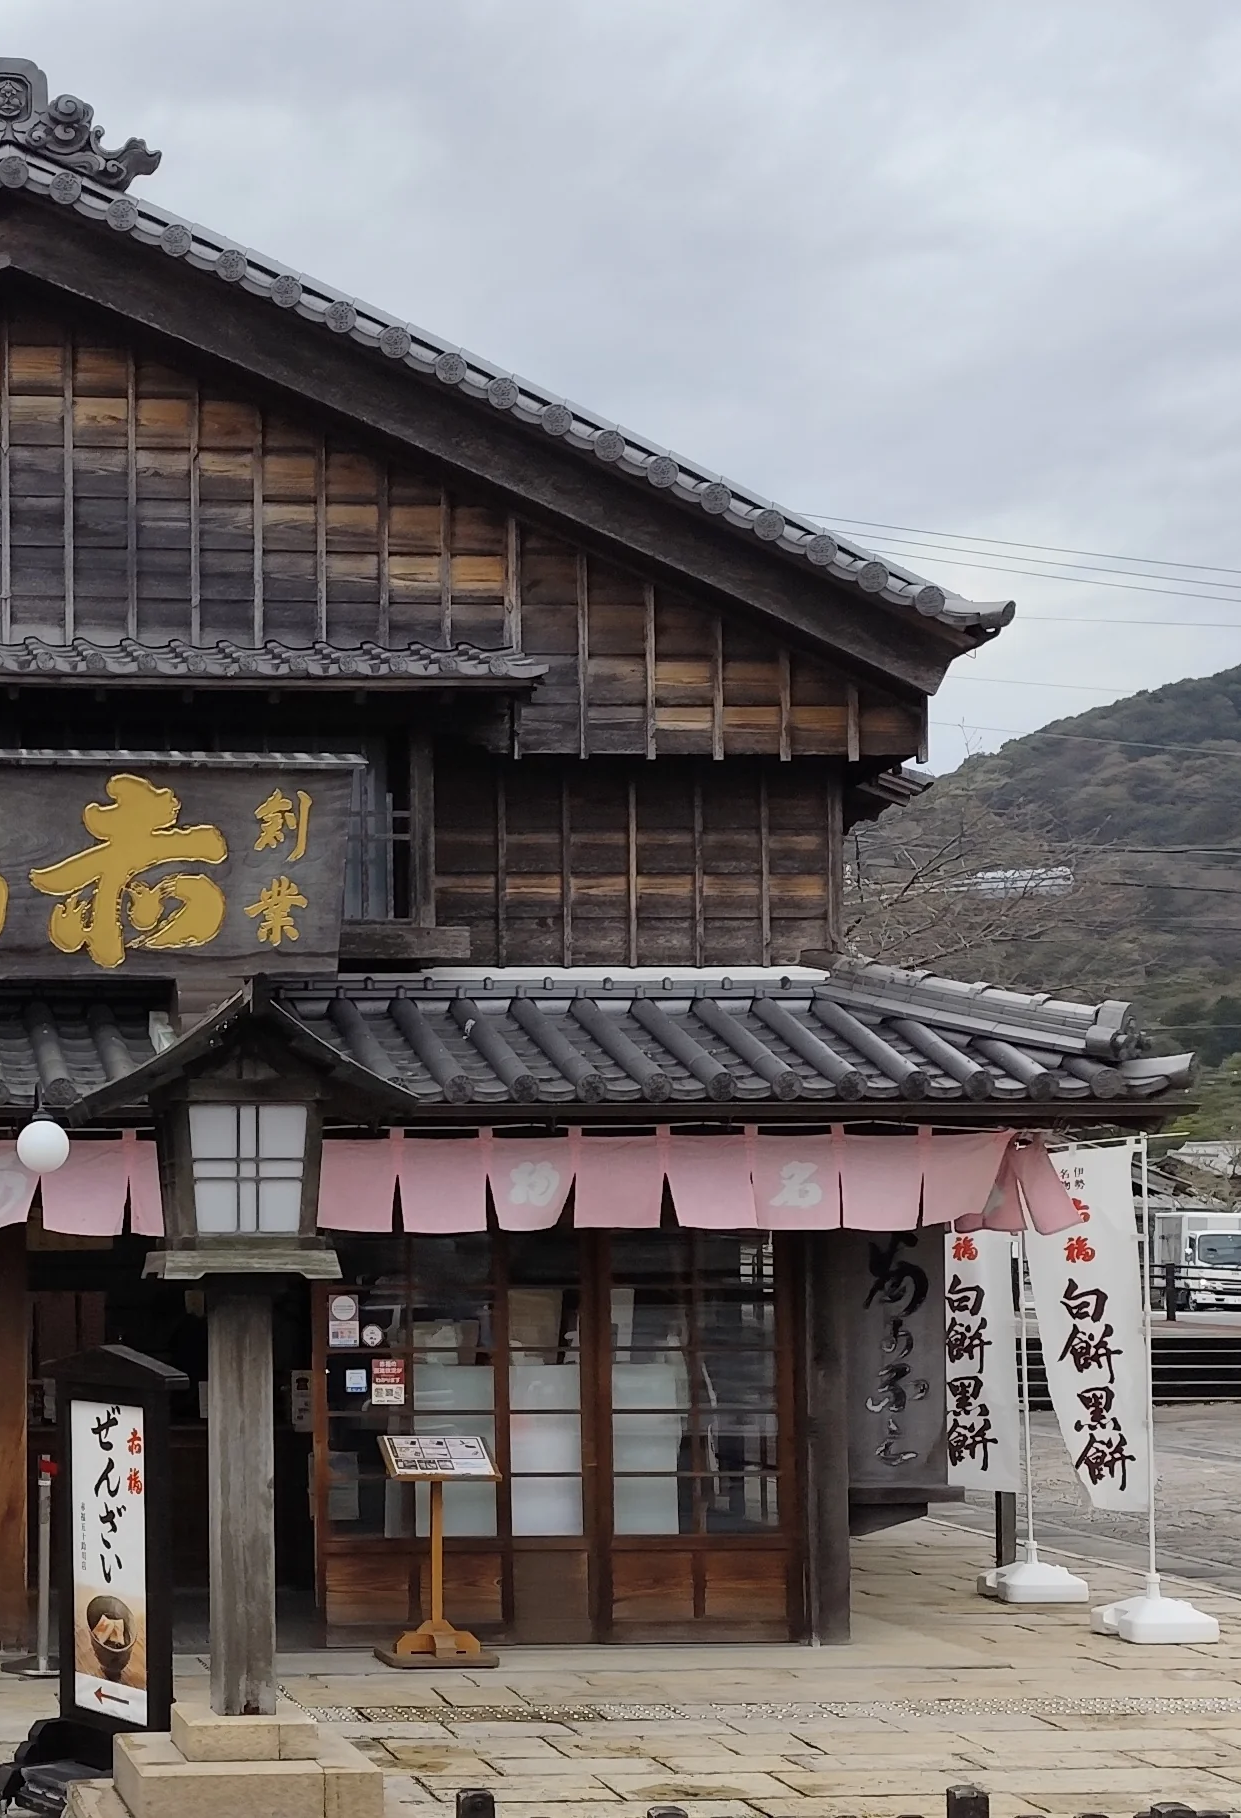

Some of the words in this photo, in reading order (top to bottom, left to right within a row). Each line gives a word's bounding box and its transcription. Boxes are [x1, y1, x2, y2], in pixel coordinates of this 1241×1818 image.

[243, 788, 314, 946] 創業
[1073, 1166, 1086, 1190] 伊勢
[91, 1406, 127, 1584] ぜんざい
[126, 1427, 143, 1496] 赤福
